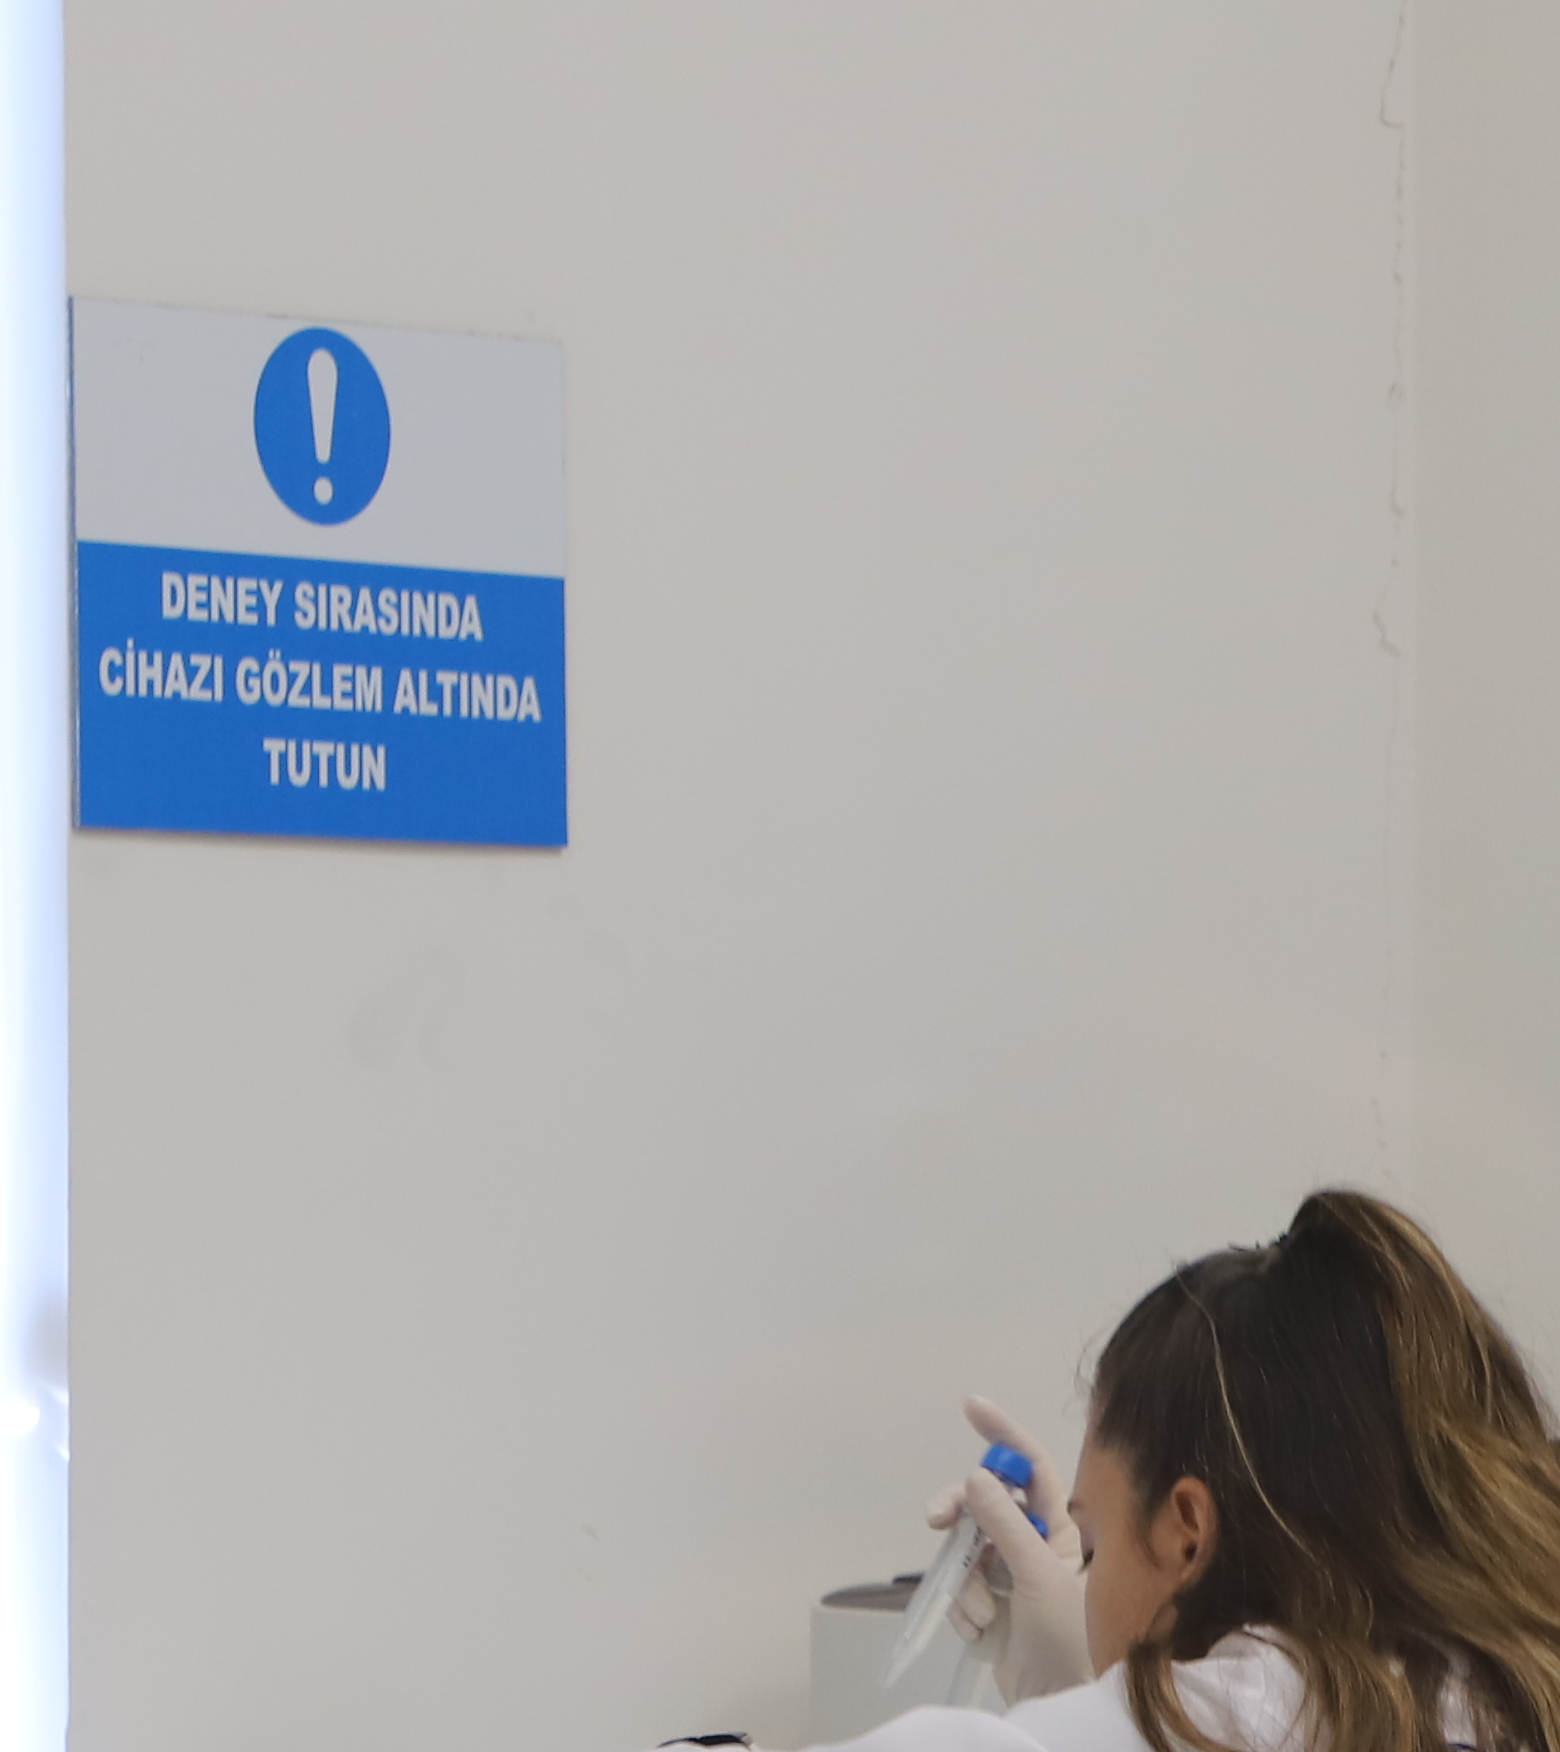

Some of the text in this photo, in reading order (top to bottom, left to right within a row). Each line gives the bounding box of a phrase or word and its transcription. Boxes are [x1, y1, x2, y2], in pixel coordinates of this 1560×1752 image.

[162, 572, 483, 641] DENEY SIRASINDA
[99, 638, 542, 723] CİHAZI GÖZLEM ALTINDA
[263, 738, 387, 791] TUTUN
